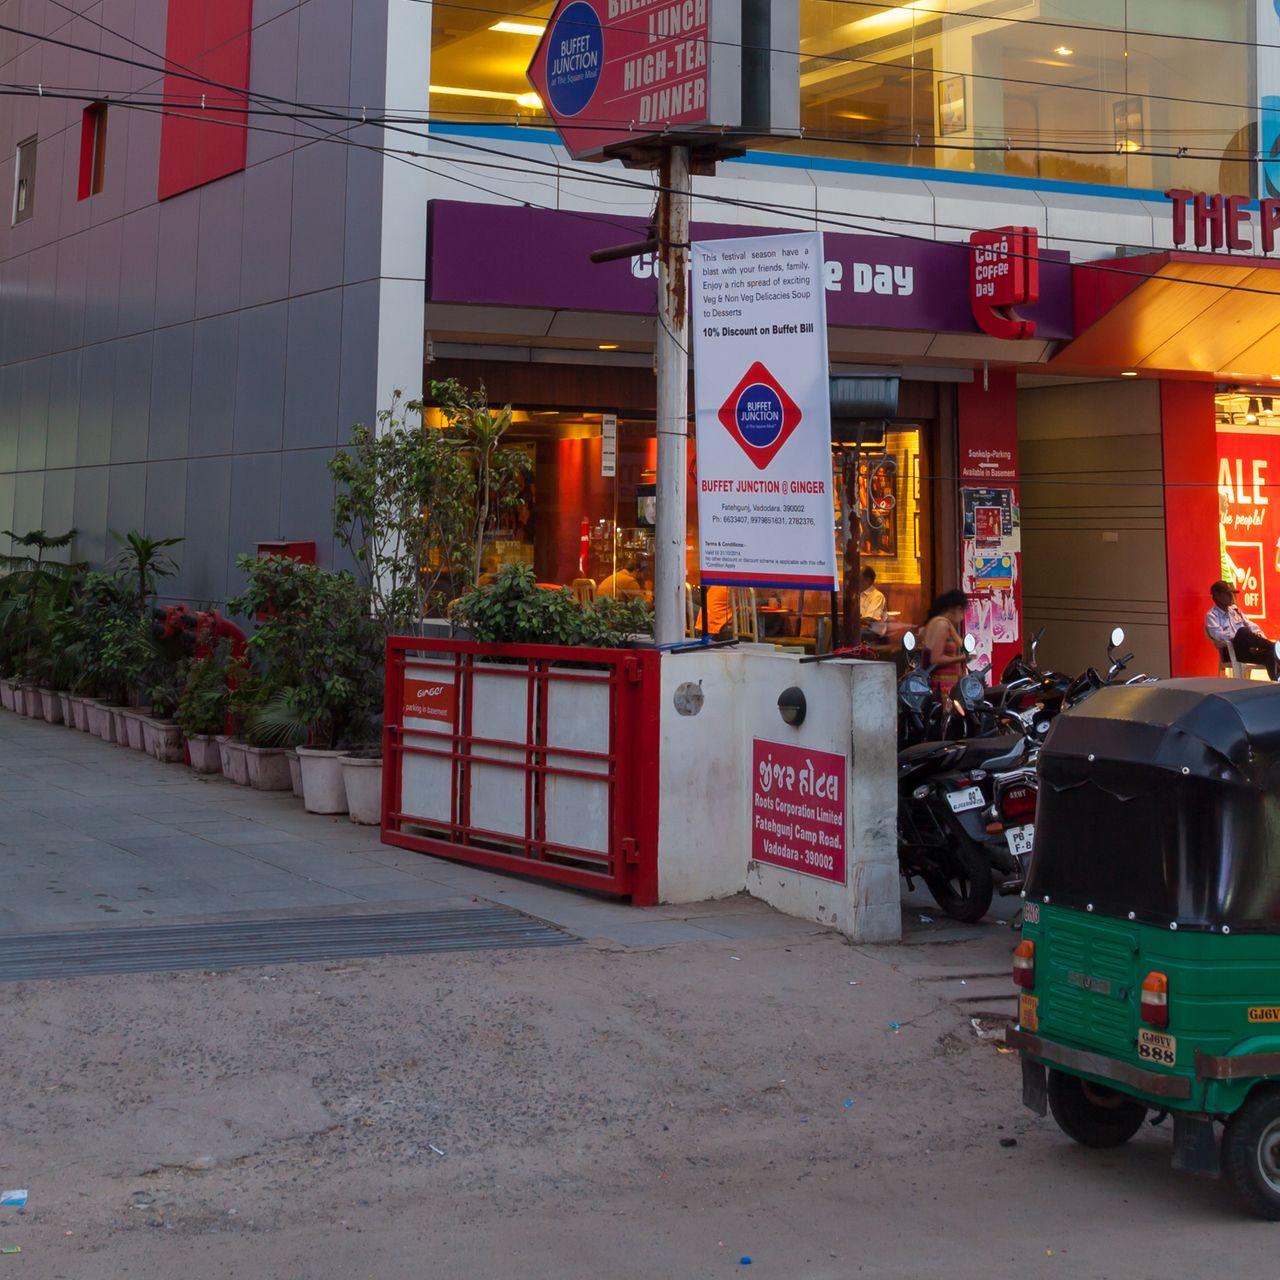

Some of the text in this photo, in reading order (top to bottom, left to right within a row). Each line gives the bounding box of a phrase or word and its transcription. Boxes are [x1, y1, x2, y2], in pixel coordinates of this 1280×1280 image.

[560, 34, 591, 56] BUFFET
[551, 50, 598, 76] JUNCTION
[624, 36, 707, 92] HIGH-TEA
[639, 77, 706, 125] DINNER
[1165, 188, 1253, 251] THE
[722, 248, 799, 261] festival season have
[722, 266, 755, 278] with your
[703, 276, 810, 291] Enjoy rich spread exciting
[703, 290, 811, 305] Veg Non Veg Delicacies Soup
[712, 308, 742, 318] Desserts
[703, 323, 814, 337] 10% Discount on Buffet Bill
[747, 401, 772, 412] BUFFET
[741, 410, 779, 421] JUNCTION
[963, 468, 1016, 478] Available Basement
[701, 480, 825, 494] BUFFET JUNCTION GINGER
[800, 759, 839, 801] હોટલ
[754, 793, 843, 827] Roots Corporation Limited
[755, 816, 843, 850] Fatehgunj Camp Road.
[763, 839, 834, 871] Vadodara 390002
[1138, 1044, 1175, 1064] 888
